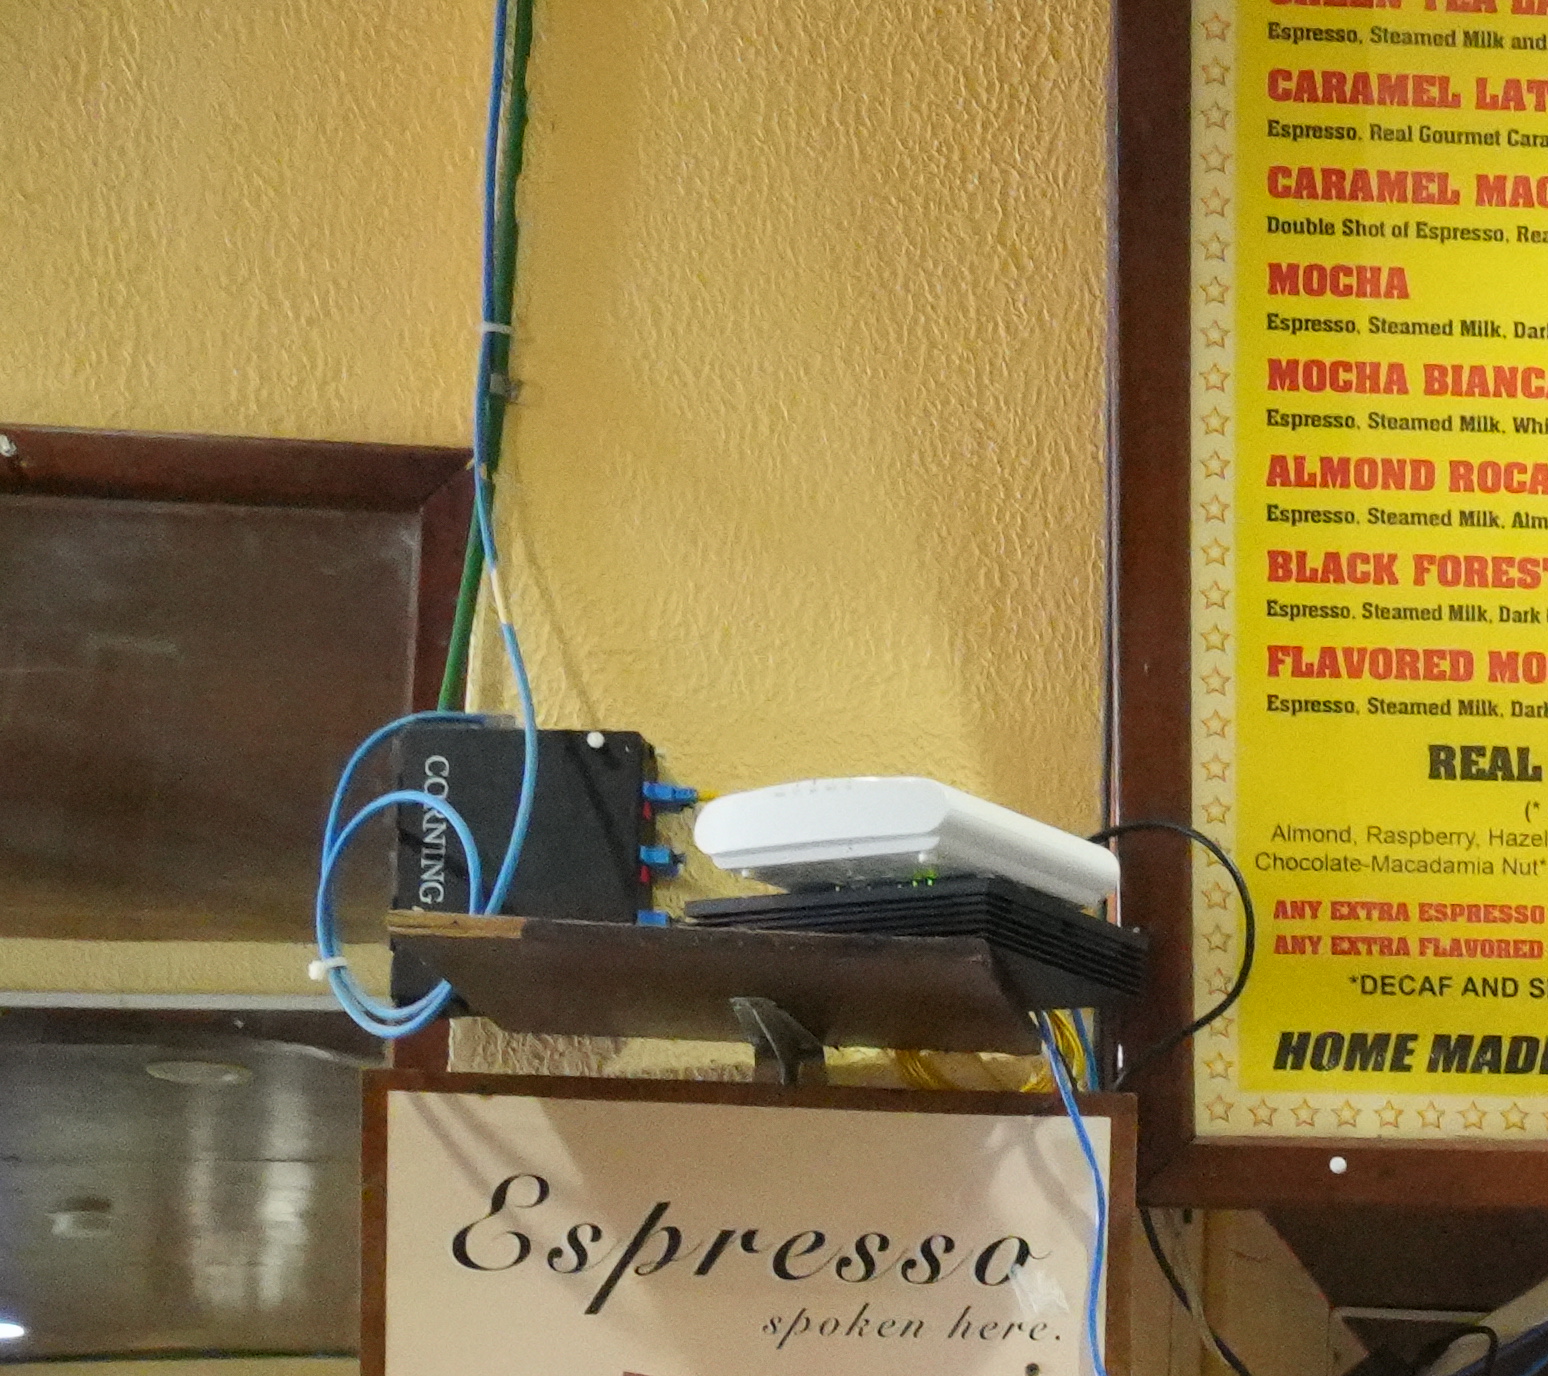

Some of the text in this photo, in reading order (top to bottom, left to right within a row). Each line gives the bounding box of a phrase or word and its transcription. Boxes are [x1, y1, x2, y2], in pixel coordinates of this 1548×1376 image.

[1268, 69, 1460, 107] CARAMEL
[1267, 120, 1363, 146] Espresso,
[1370, 124, 1412, 142] Real
[1419, 125, 1500, 146] Gourmet
[1429, 745, 1542, 781] REAL
[1274, 1032, 1418, 1072] HOME
[453, 1175, 1050, 1315] Espresso
[763, 1303, 1063, 1349] spoken here.
